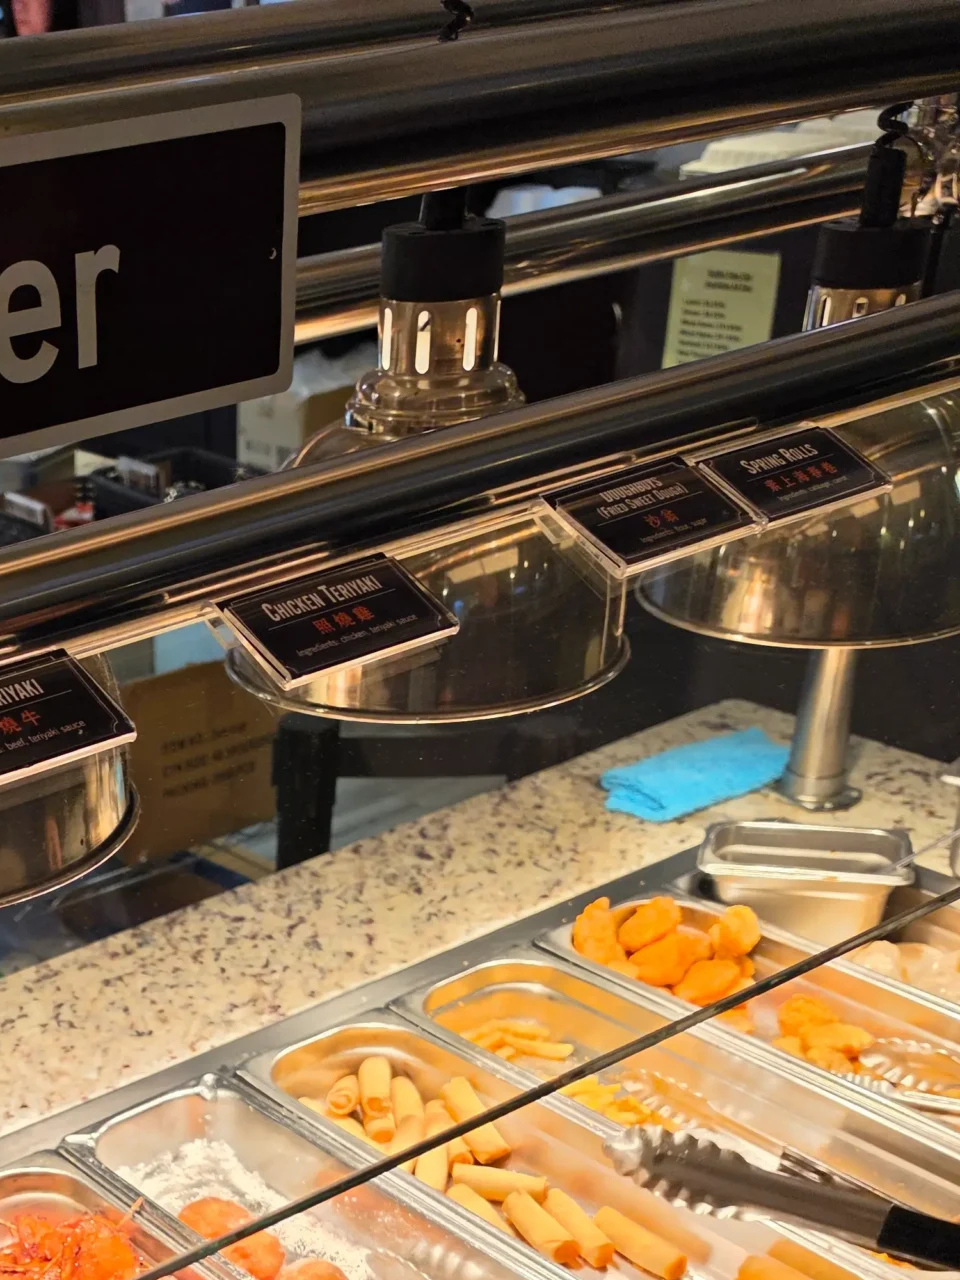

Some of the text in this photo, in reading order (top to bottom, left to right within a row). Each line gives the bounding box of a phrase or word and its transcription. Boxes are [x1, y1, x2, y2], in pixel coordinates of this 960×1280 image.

[778, 443, 819, 462] ROLLS
[29, 728, 59, 747] teriyaki
[59, 720, 86, 735] sauce
